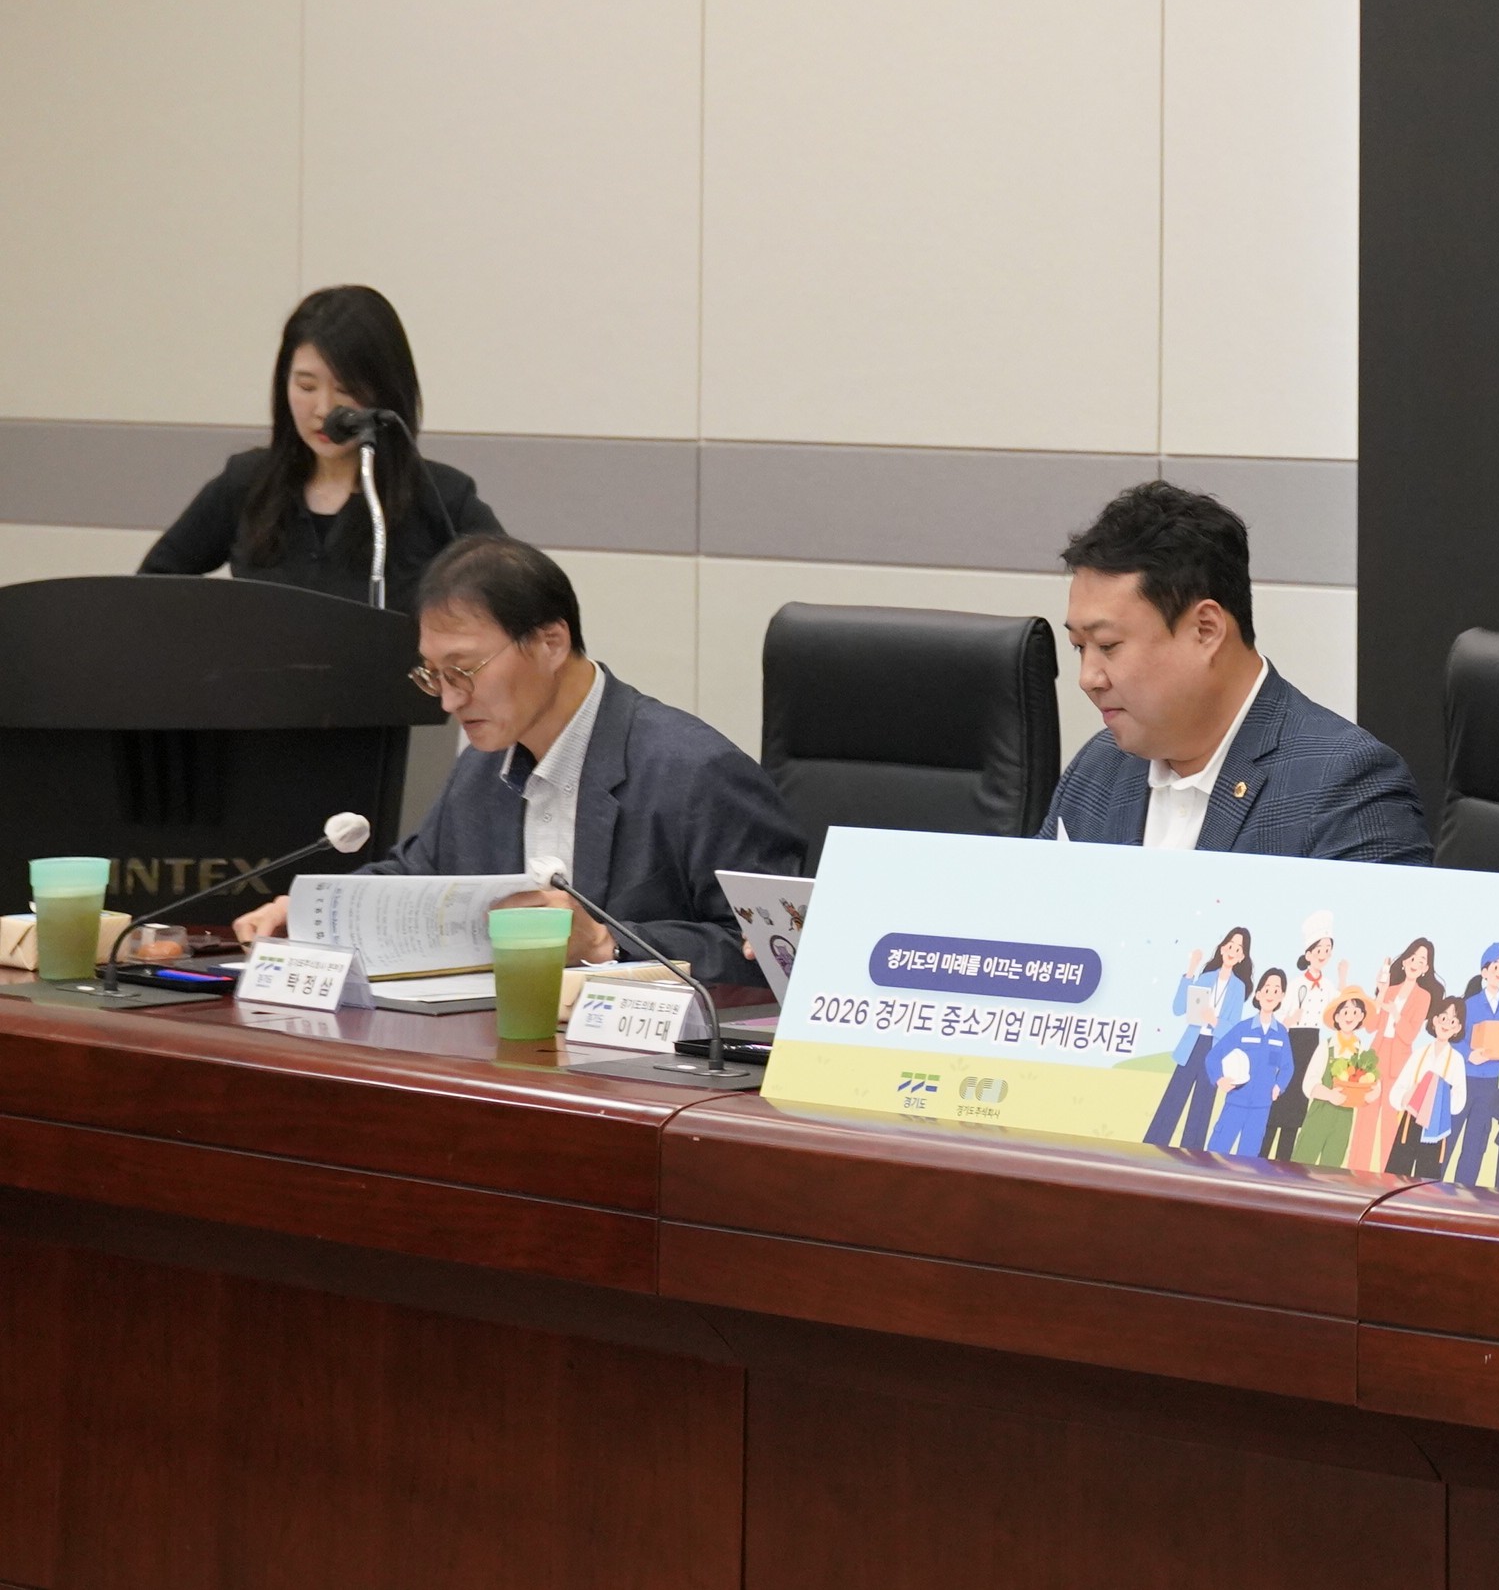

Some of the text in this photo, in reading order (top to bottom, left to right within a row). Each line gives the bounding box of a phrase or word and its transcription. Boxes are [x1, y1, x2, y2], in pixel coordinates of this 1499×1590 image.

[108, 857, 272, 896] INTEX
[887, 949, 1084, 985] 경기도의 미래를 이끄는 여성 리더
[618, 1015, 671, 1042] 이기대
[810, 996, 1139, 1053] 2026 경기도 중소기업 마케팅지원
[903, 1096, 927, 1109] 경기도
